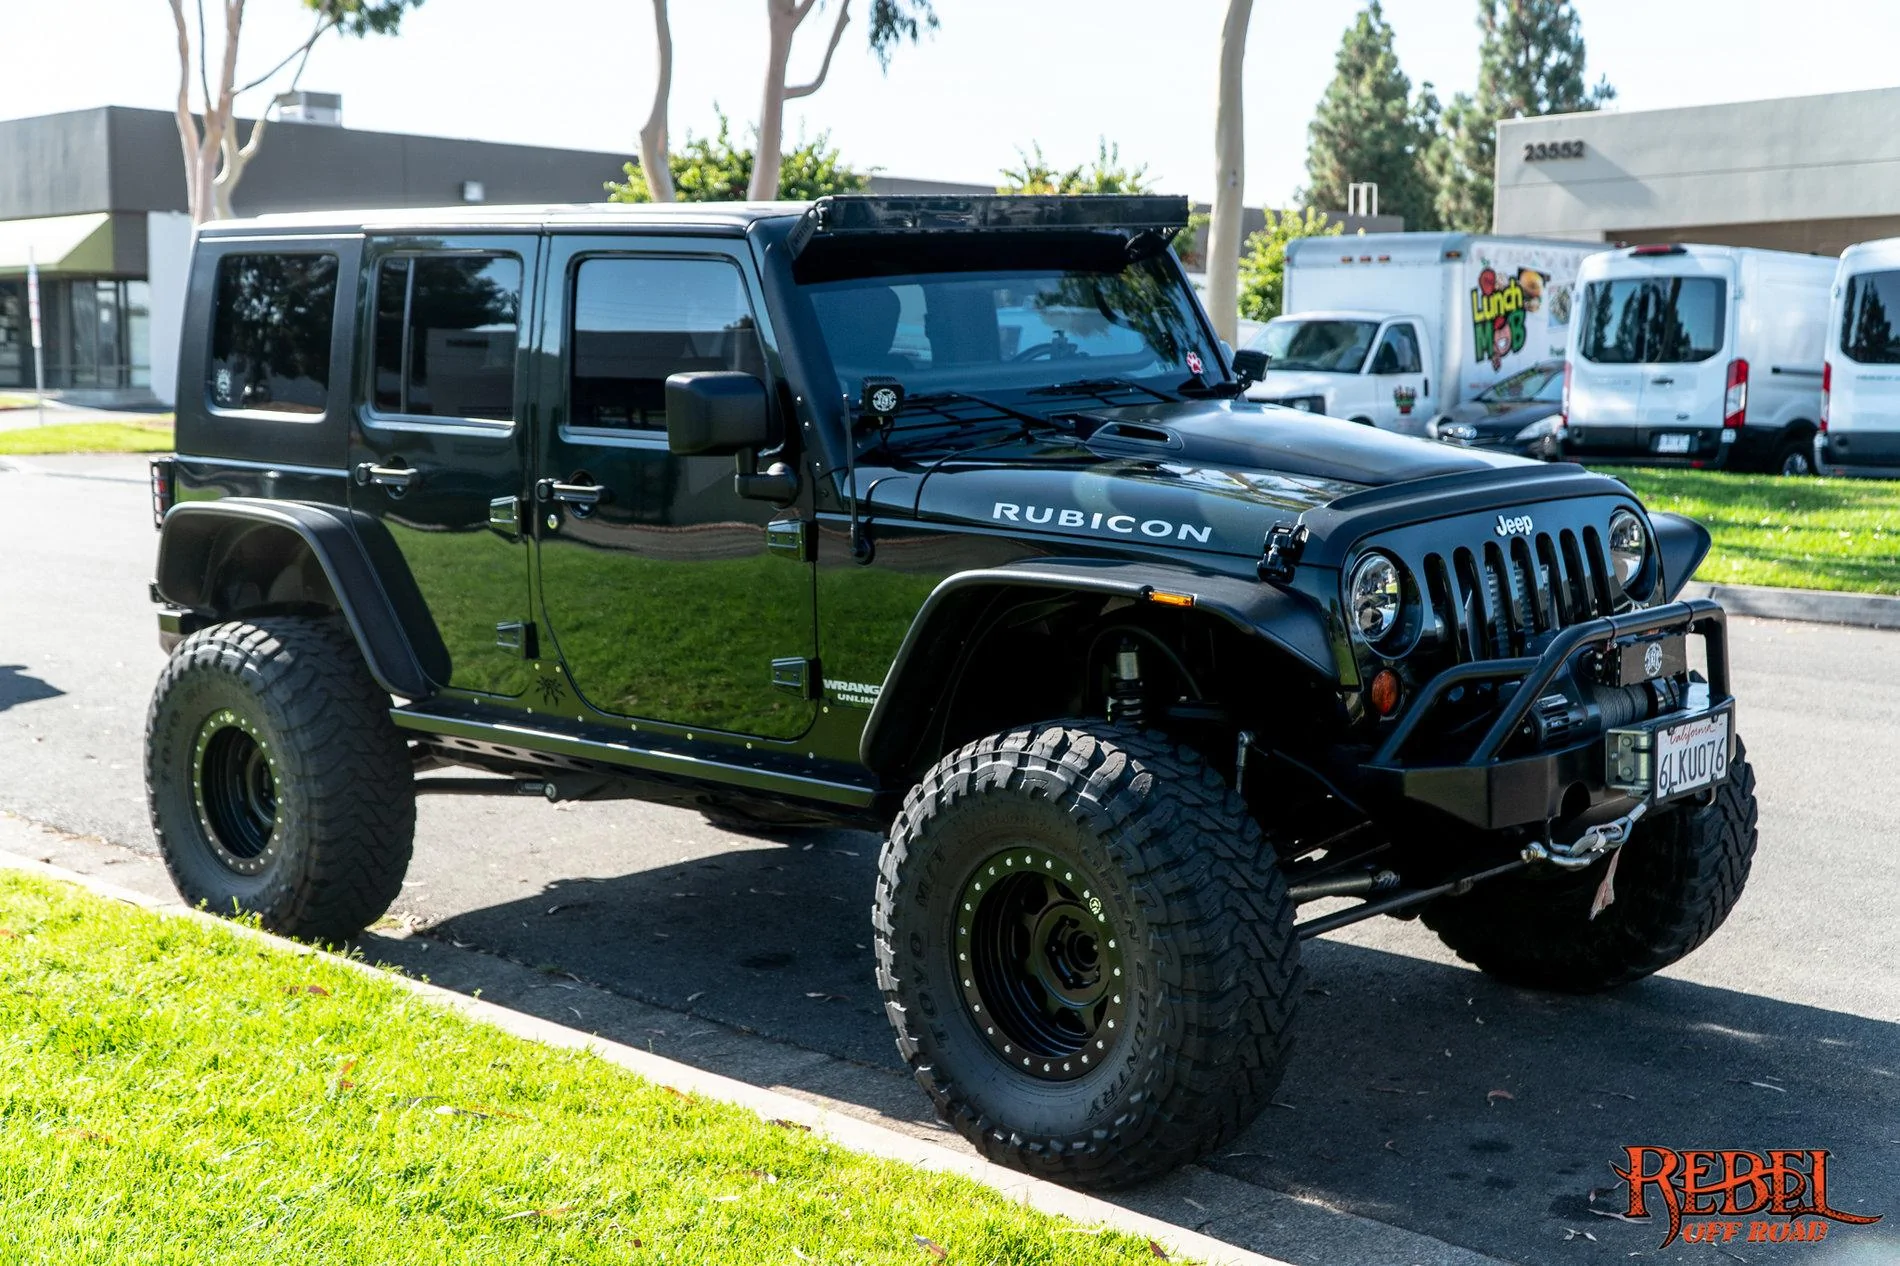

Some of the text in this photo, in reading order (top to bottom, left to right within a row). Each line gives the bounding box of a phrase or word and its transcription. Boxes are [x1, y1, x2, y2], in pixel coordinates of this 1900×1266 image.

[1525, 140, 1584, 161] 23552
[1471, 276, 1524, 323] Lunch
[992, 502, 1213, 544] RUBICON
[1495, 514, 1534, 537] Jeep
[1669, 722, 1716, 745] California
[1659, 737, 1725, 790] 6LKU076
